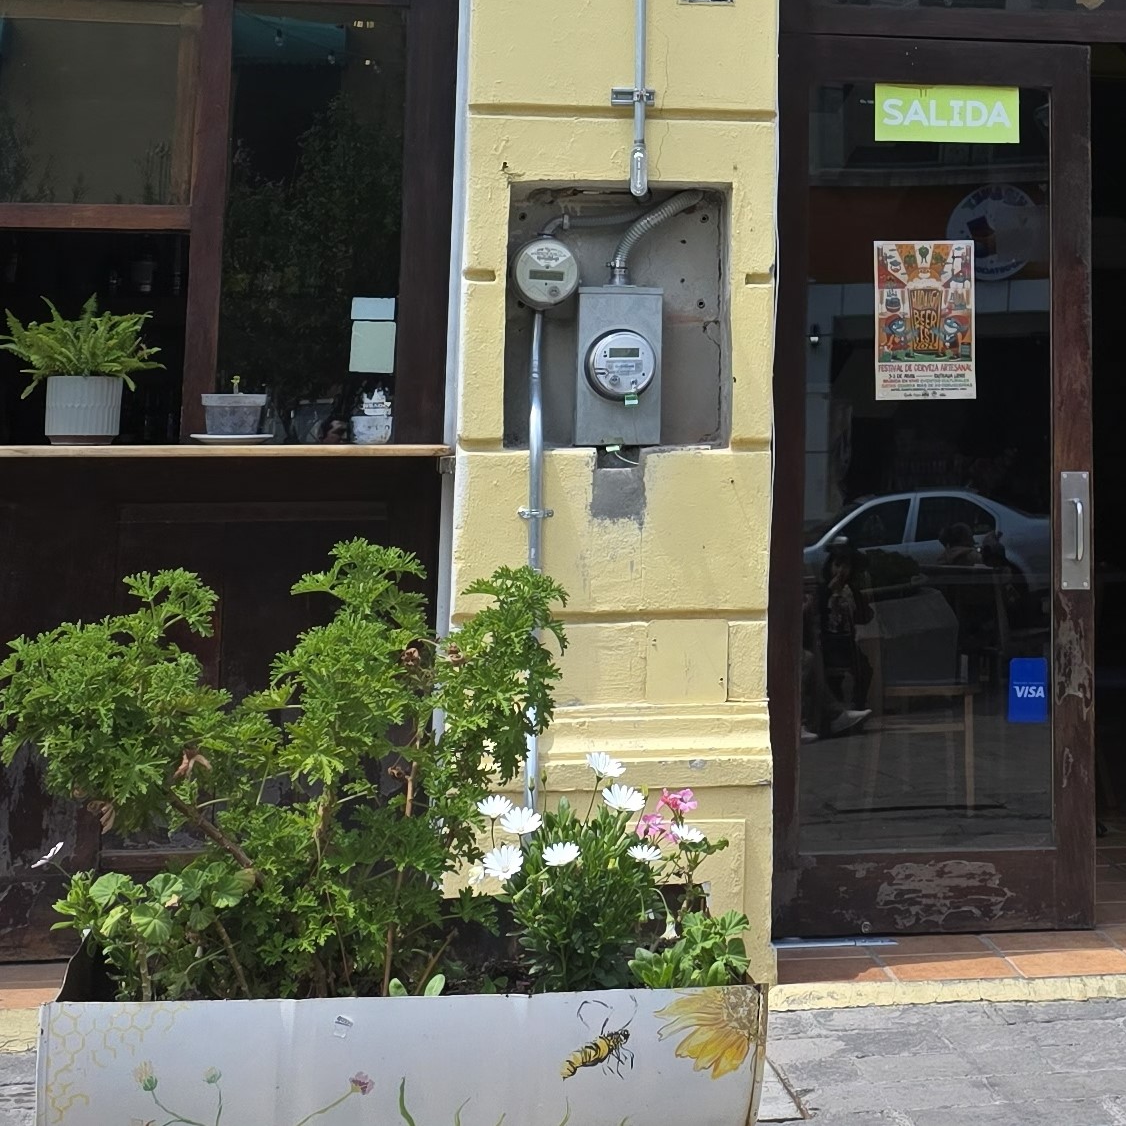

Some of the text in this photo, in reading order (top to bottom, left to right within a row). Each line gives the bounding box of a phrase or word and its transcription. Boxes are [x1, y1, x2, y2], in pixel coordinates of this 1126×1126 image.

[882, 98, 1012, 128] SALIDA
[913, 309, 937, 329] BEER
[878, 363, 972, 373] FESTIVAL DE CERVEZA ARTESANAL
[1013, 685, 1045, 698] VISA
